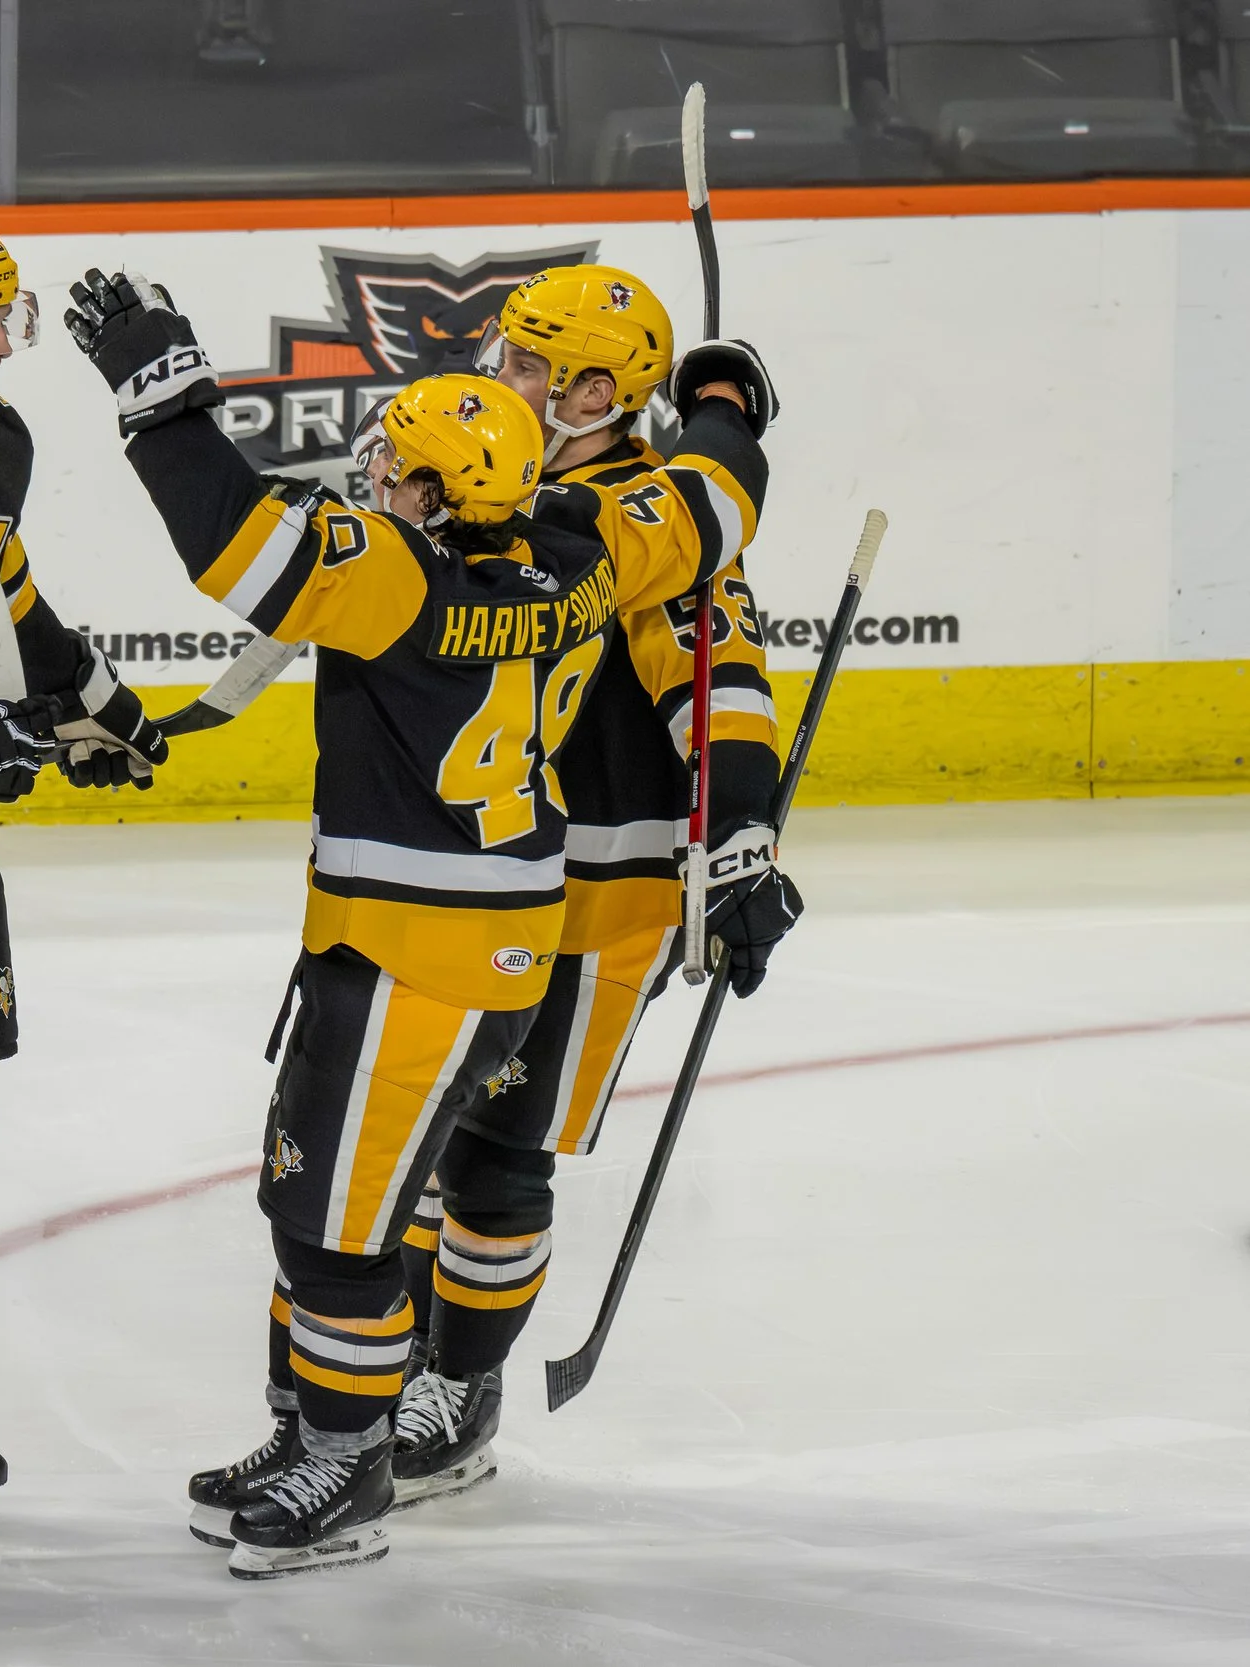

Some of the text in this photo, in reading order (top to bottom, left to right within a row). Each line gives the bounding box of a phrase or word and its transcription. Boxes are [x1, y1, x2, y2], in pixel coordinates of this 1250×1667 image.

[507, 302, 518, 317] CM
[520, 459, 537, 486] 49
[660, 576, 764, 655] 53
[708, 844, 771, 879] CM
[502, 954, 527, 967] AHL
[247, 1470, 286, 1491] BAUER
[320, 1500, 353, 1528] BAUER
